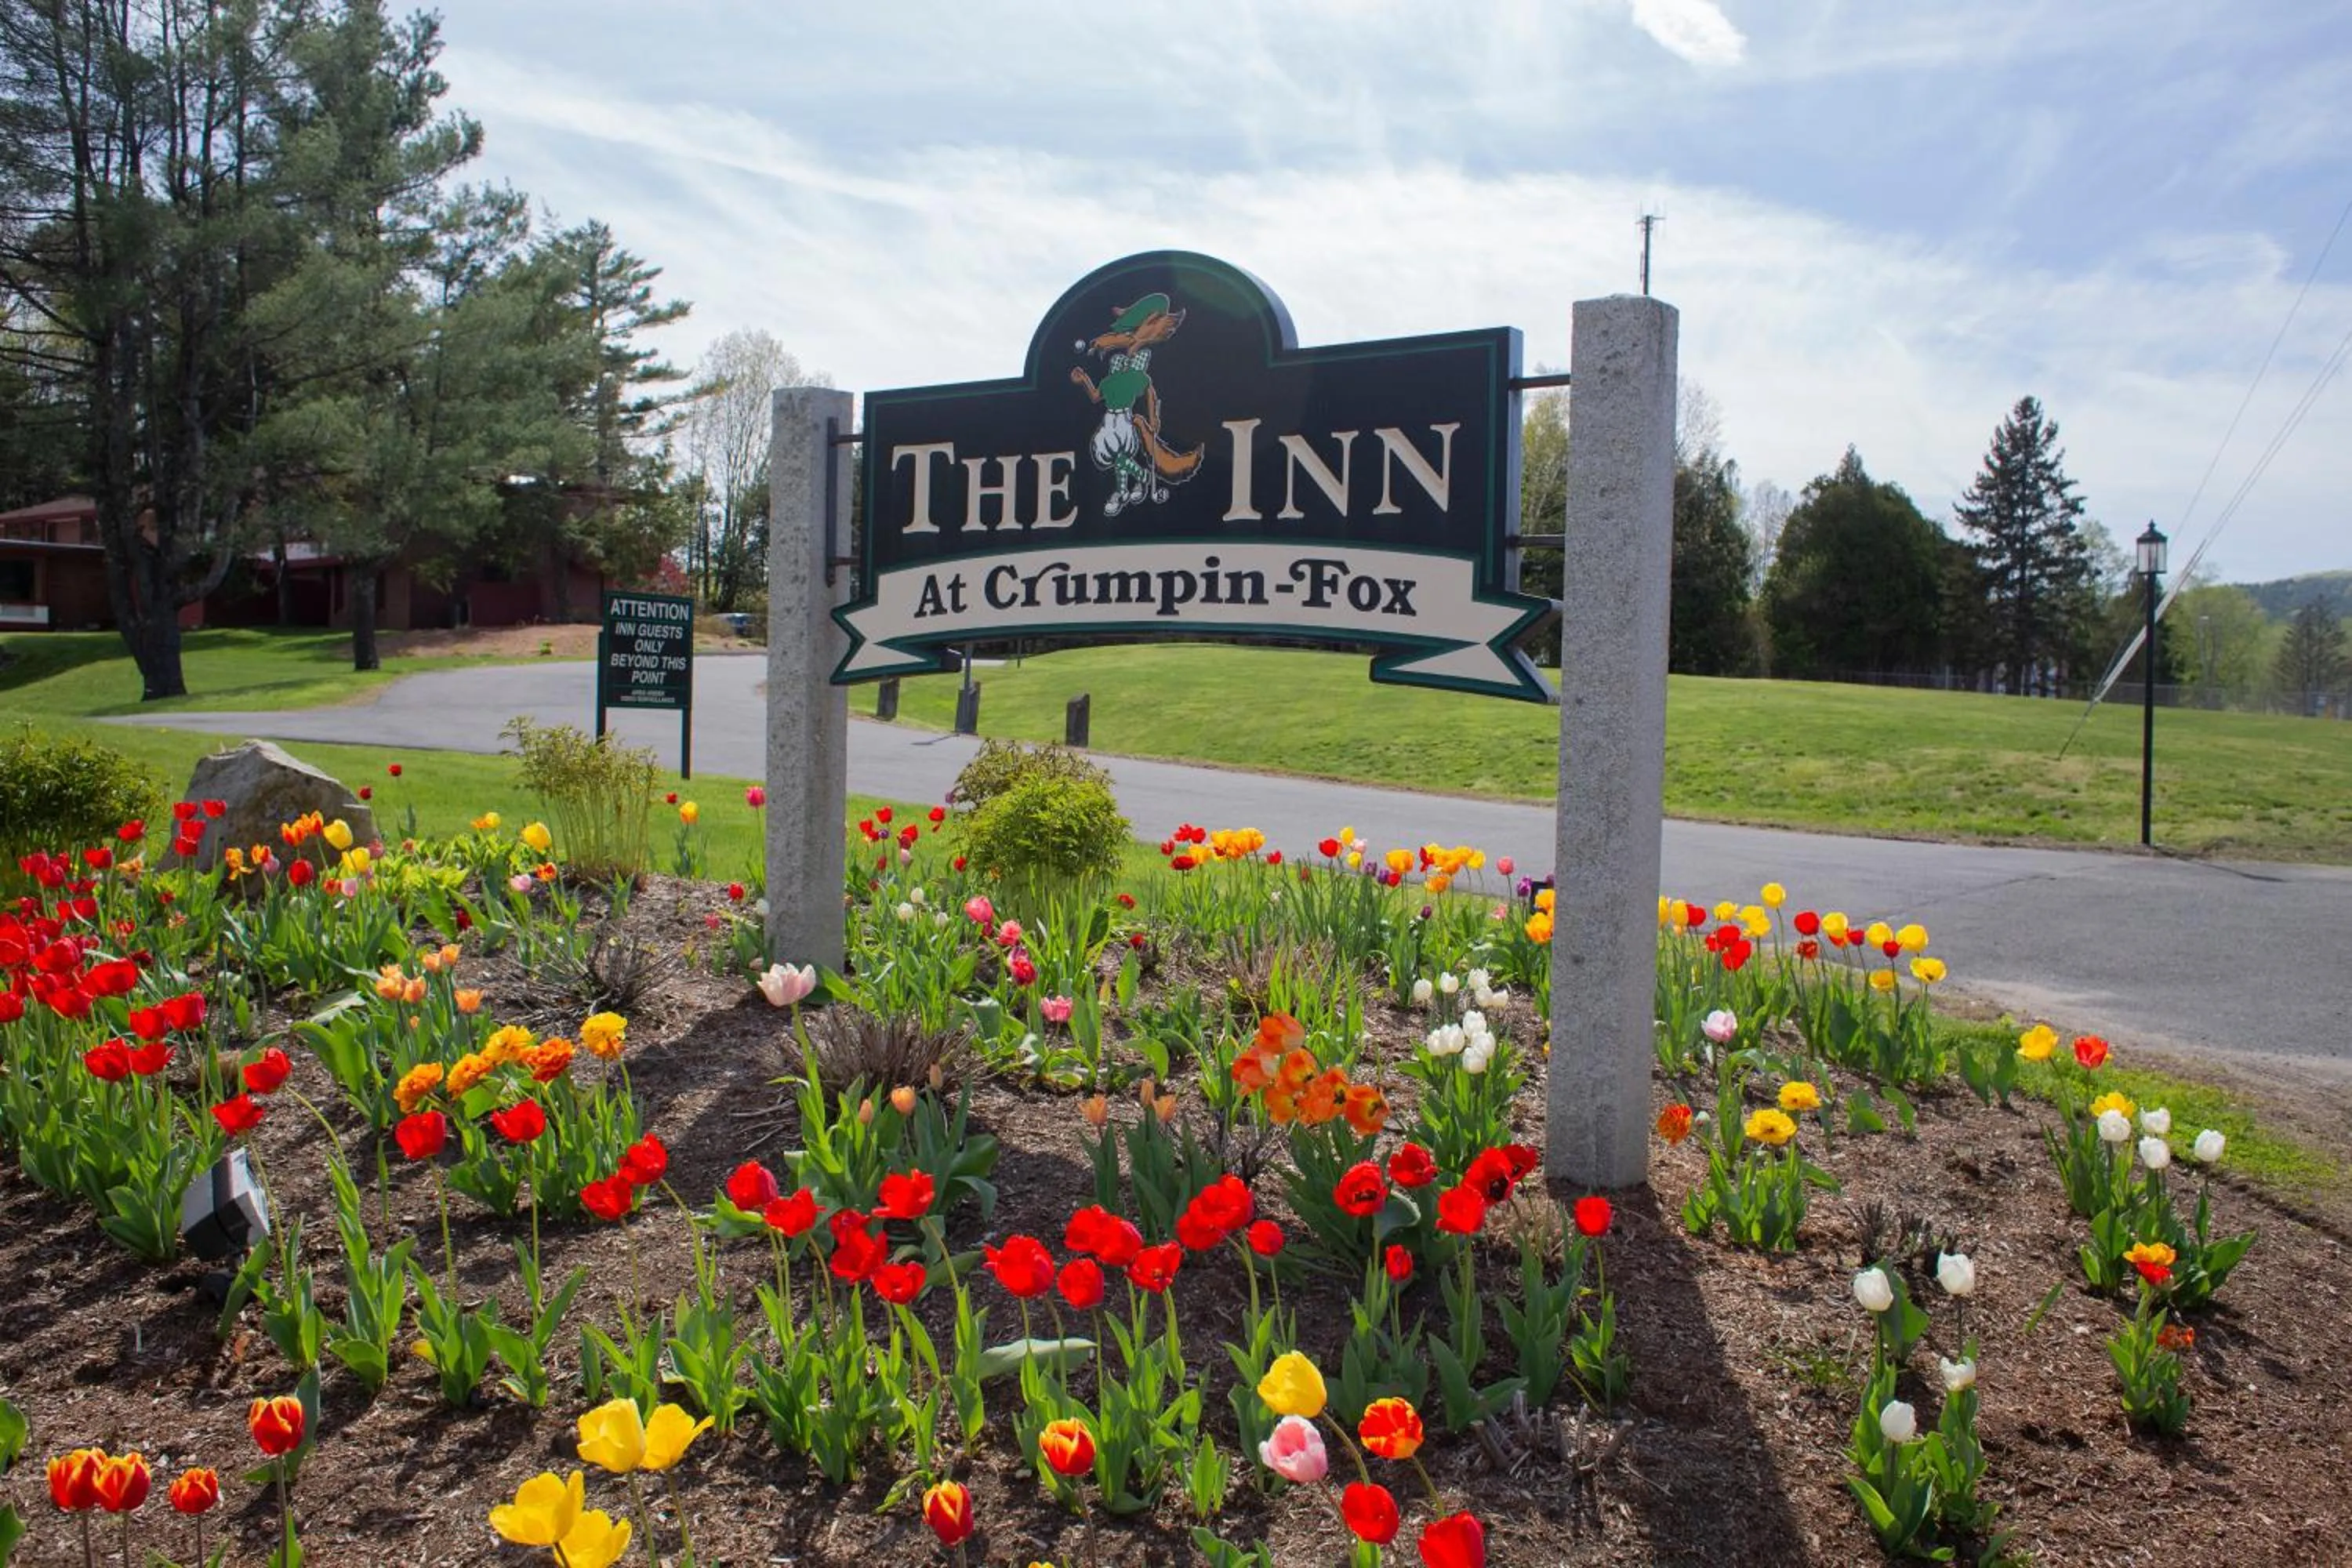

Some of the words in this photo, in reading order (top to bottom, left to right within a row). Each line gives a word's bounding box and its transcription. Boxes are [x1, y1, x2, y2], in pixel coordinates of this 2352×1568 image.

[891, 441, 1078, 534] THE
[1221, 418, 1461, 521] INN
[913, 566, 967, 618] At
[984, 556, 1417, 616] Crumpin-Fox
[611, 599, 689, 620] ATTENTION
[615, 622, 636, 636] INN
[637, 623, 684, 639] GUESTS
[634, 639, 665, 652] ONLY
[610, 653, 659, 669] BEYOND
[662, 656, 687, 670] THIS
[632, 670, 667, 684] POINT
